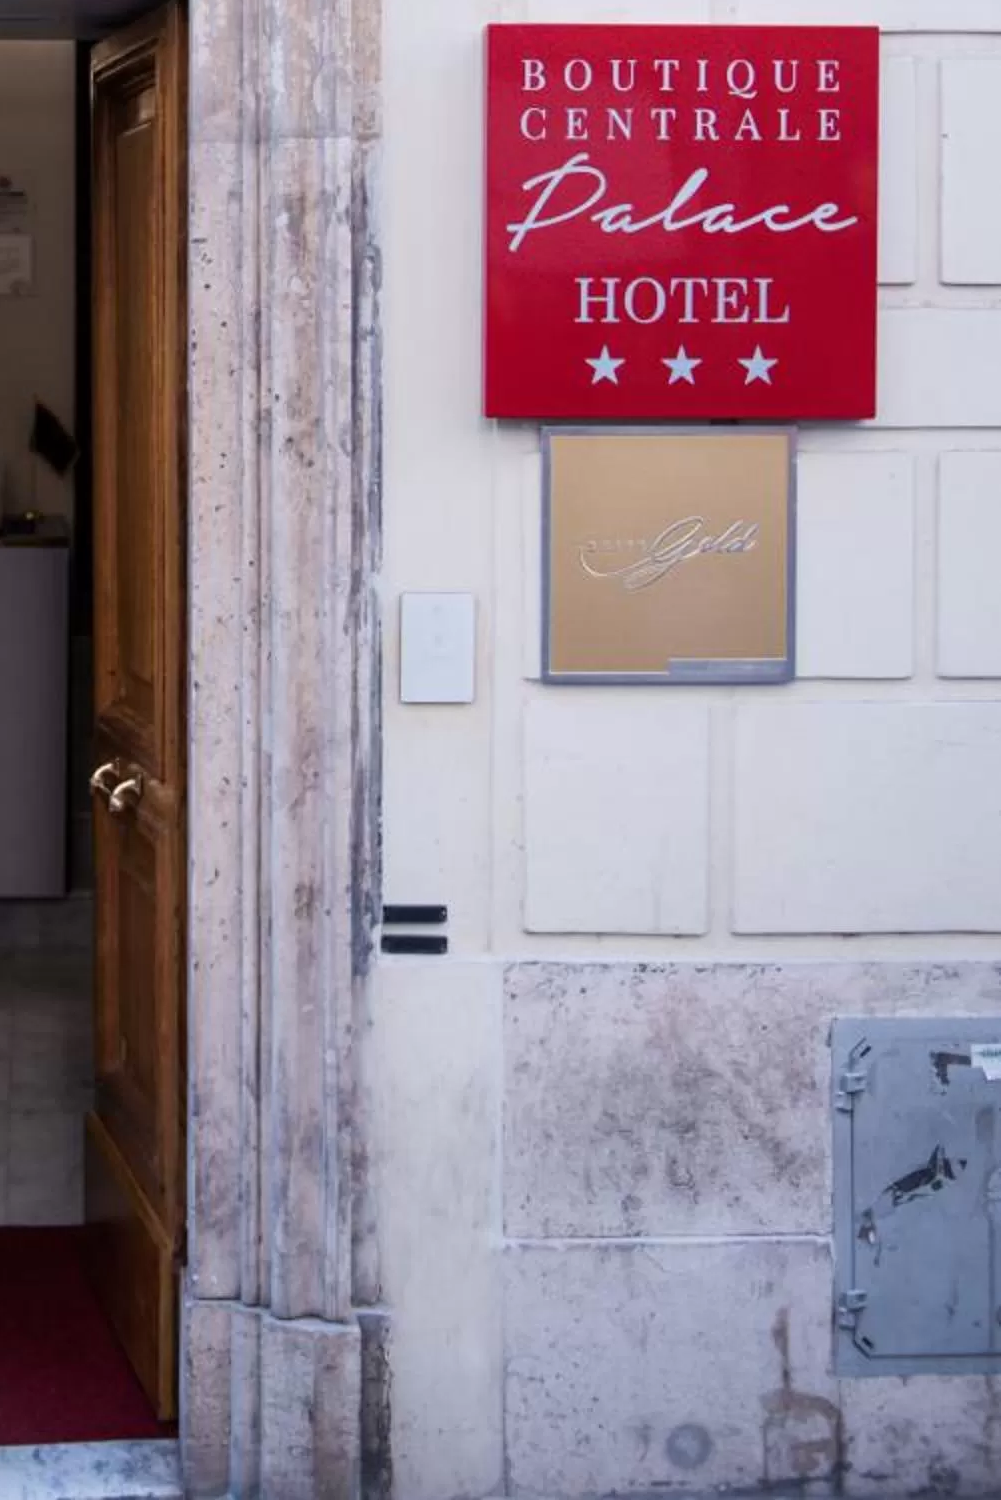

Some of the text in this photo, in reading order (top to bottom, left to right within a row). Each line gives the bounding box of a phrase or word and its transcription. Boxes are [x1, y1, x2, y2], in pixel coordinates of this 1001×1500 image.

[521, 58, 842, 99] BOUTIQUE
[520, 107, 842, 142] CENTRALE
[506, 152, 858, 253] Palace
[574, 277, 791, 324] HOTEL
[591, 515, 759, 594] Gold
